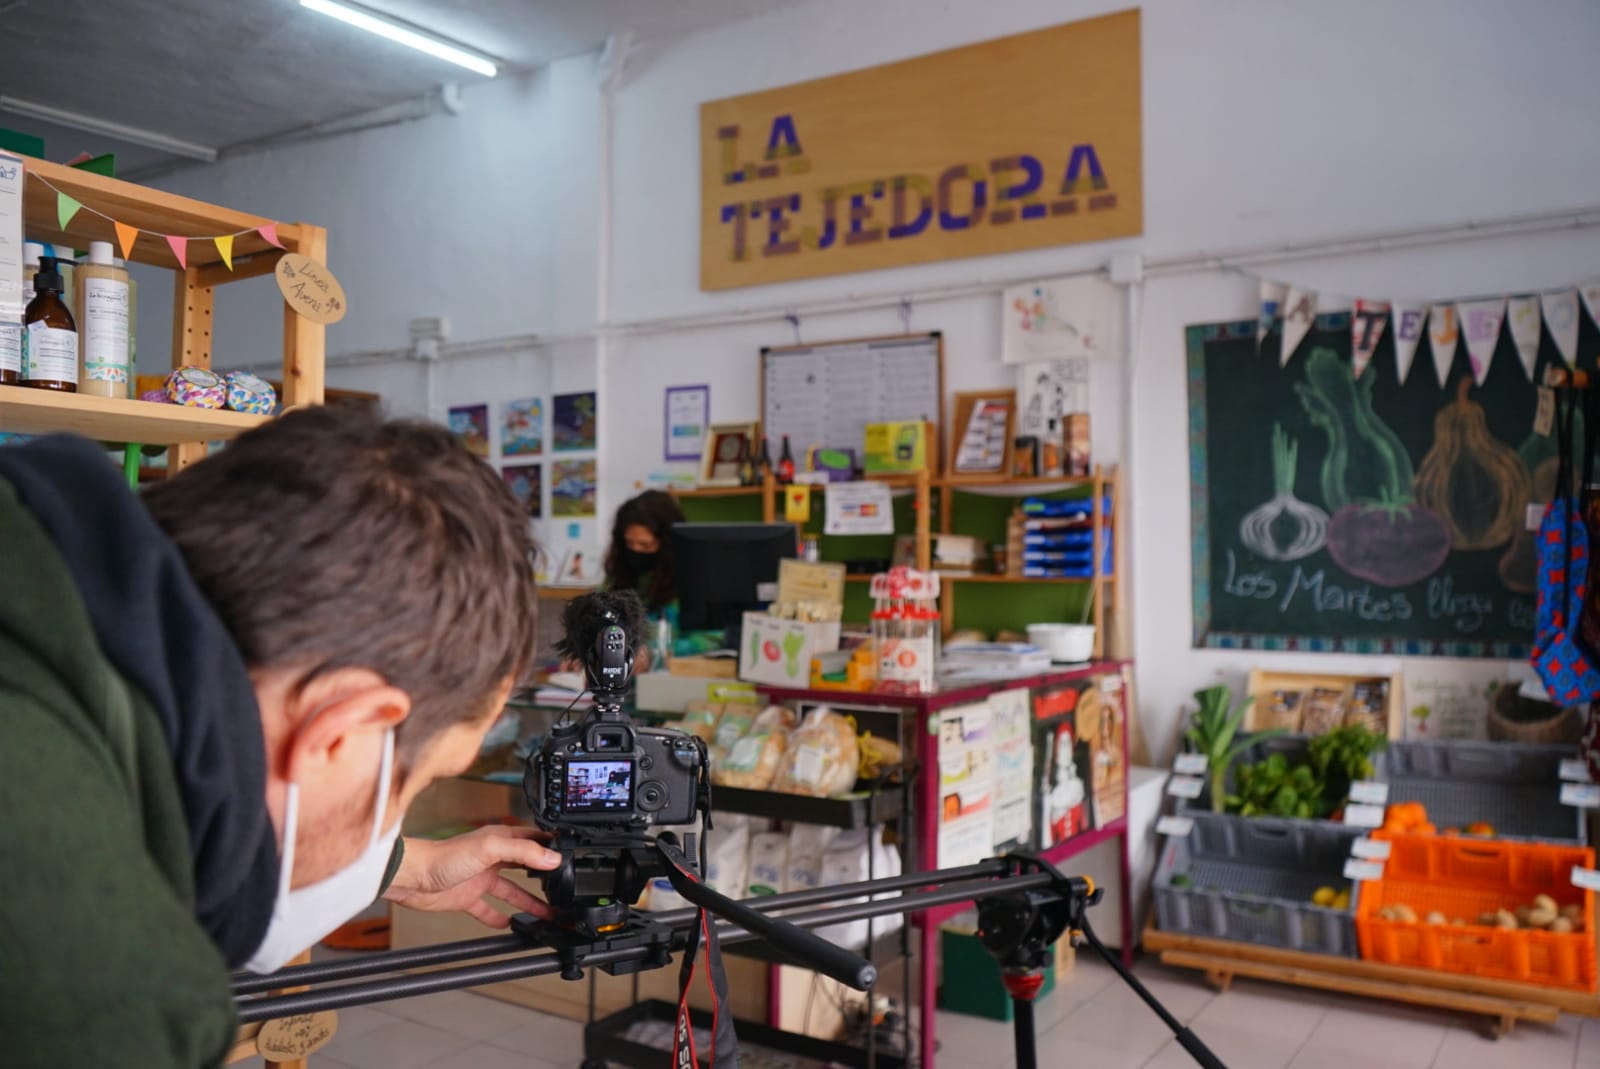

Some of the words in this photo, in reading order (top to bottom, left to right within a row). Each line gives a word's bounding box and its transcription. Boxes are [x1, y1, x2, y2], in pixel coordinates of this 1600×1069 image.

[718, 114, 811, 185] LA
[720, 144, 1117, 263] TEJEDORA
[1224, 551, 1278, 600] Los
[1280, 566, 1413, 621] Martes
